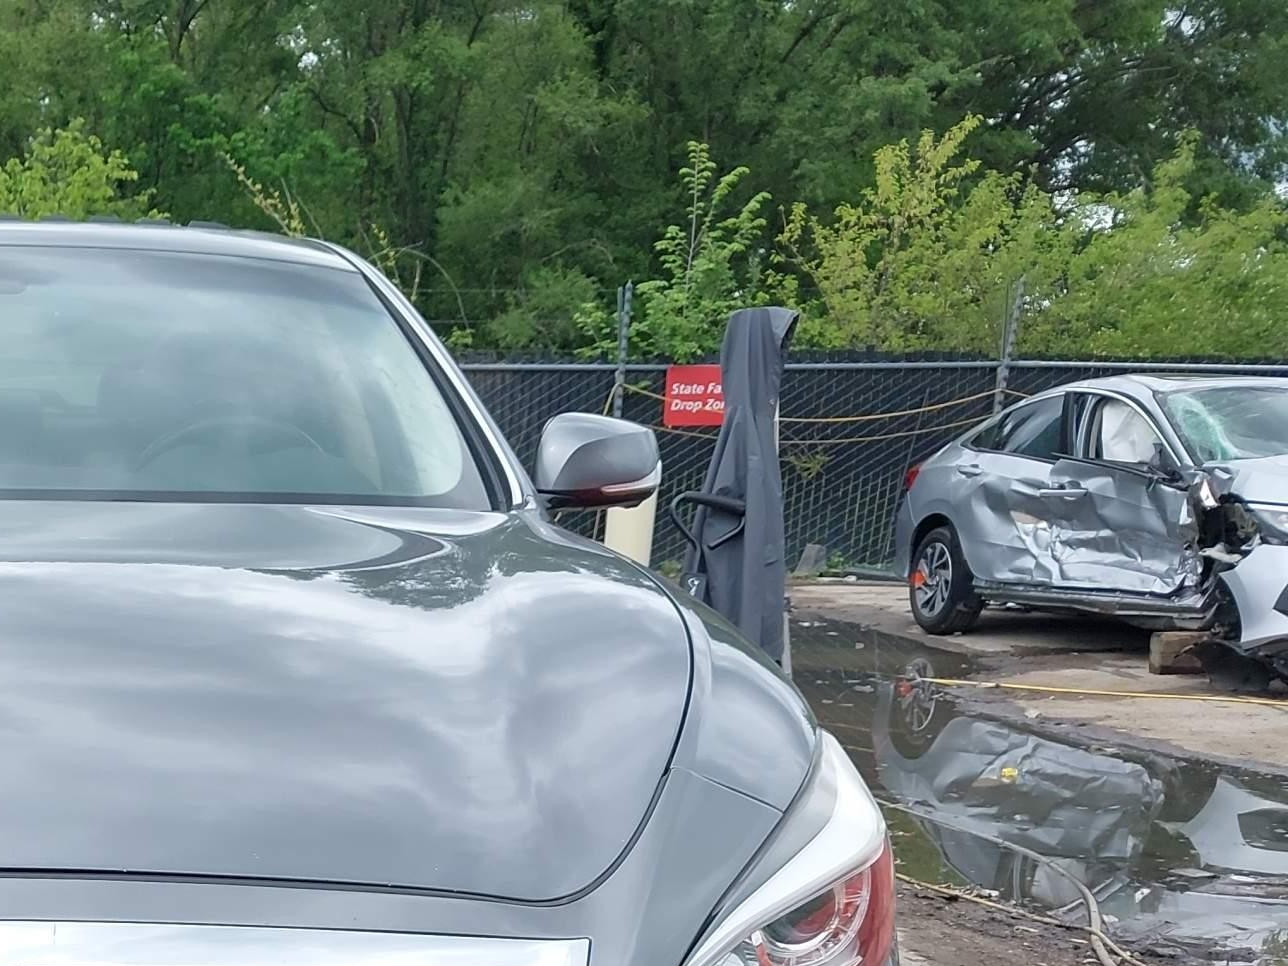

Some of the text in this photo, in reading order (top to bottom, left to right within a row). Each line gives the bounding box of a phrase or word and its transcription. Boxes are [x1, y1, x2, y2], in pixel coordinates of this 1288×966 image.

[670, 382, 723, 395] State Fa
[670, 399, 703, 413] Drop
